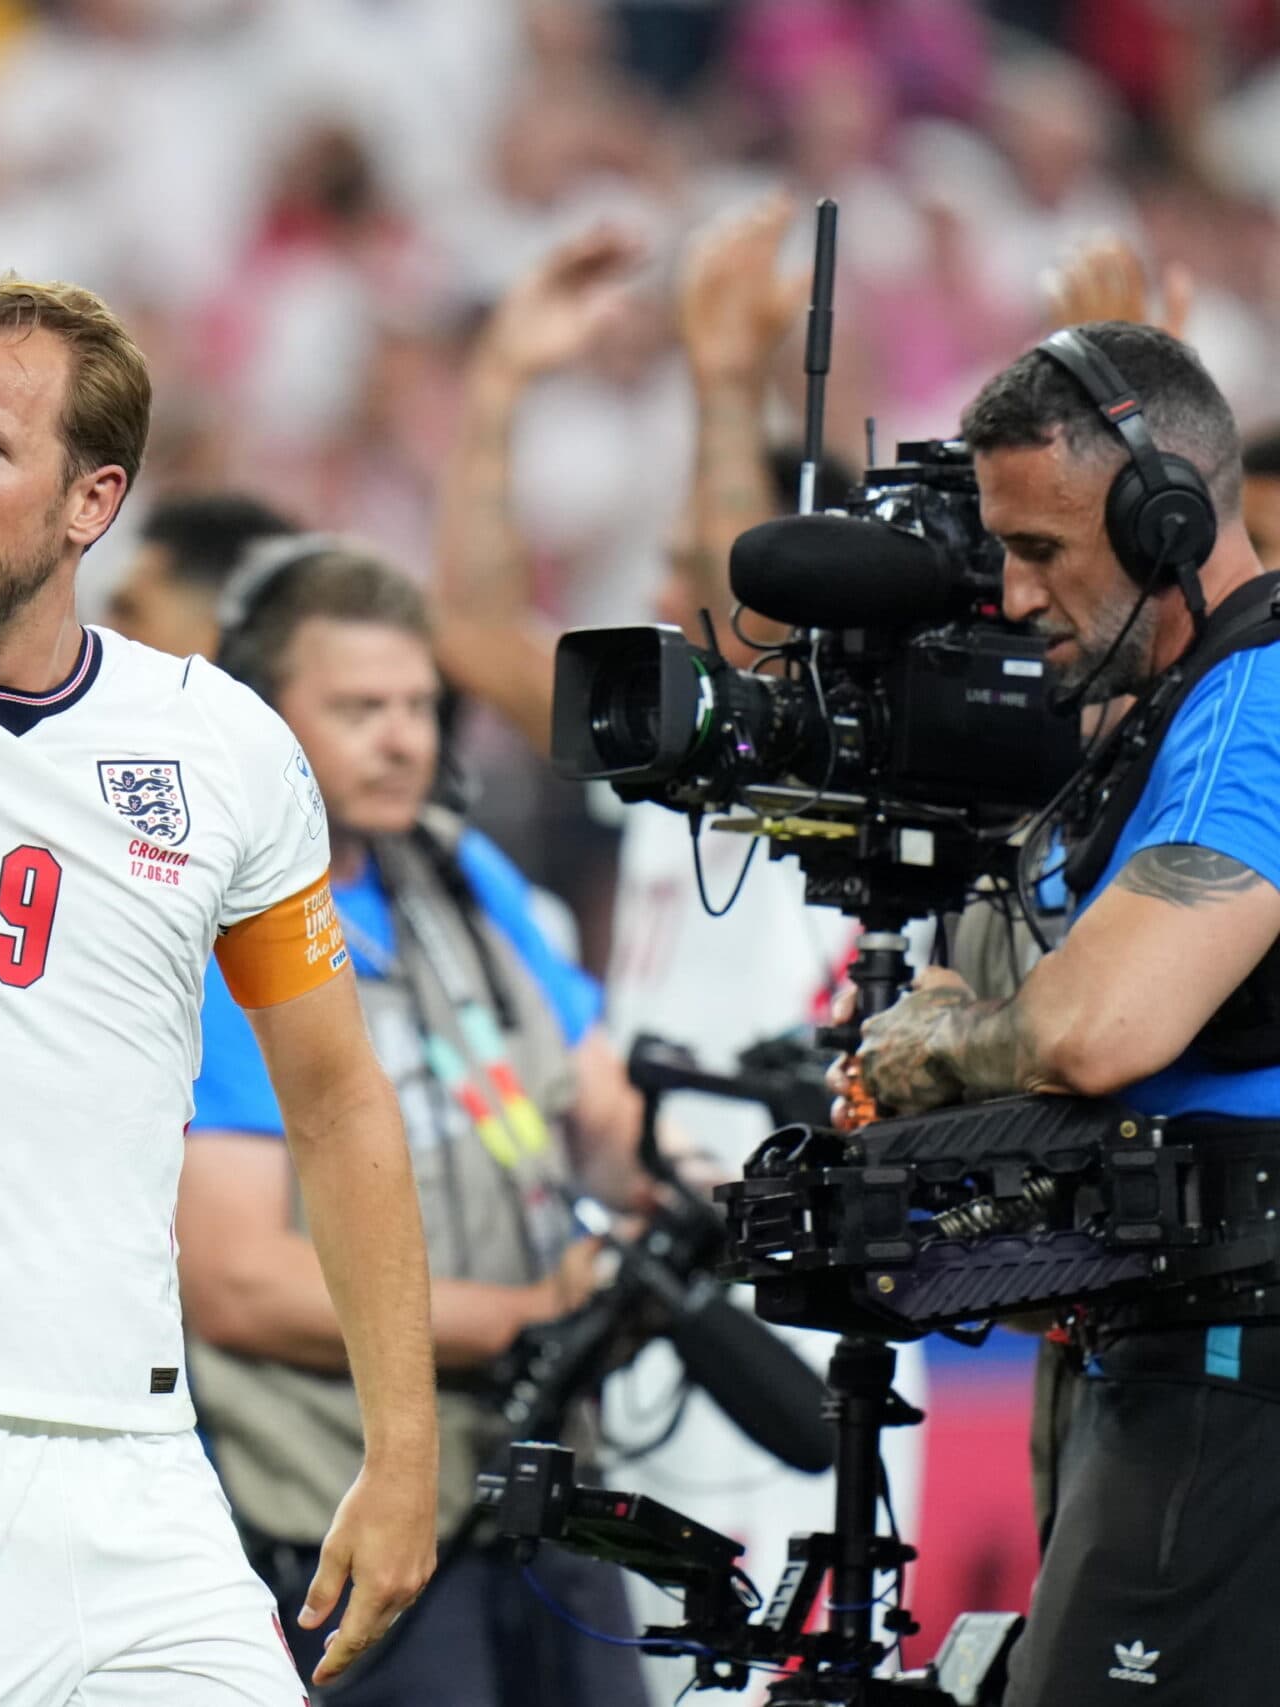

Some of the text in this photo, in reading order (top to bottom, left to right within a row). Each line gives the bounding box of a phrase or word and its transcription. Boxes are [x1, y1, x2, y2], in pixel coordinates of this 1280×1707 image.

[128, 839, 190, 867] CROATIA
[130, 861, 180, 886] 17.06.26
[1108, 1667, 1158, 1684] adidas
